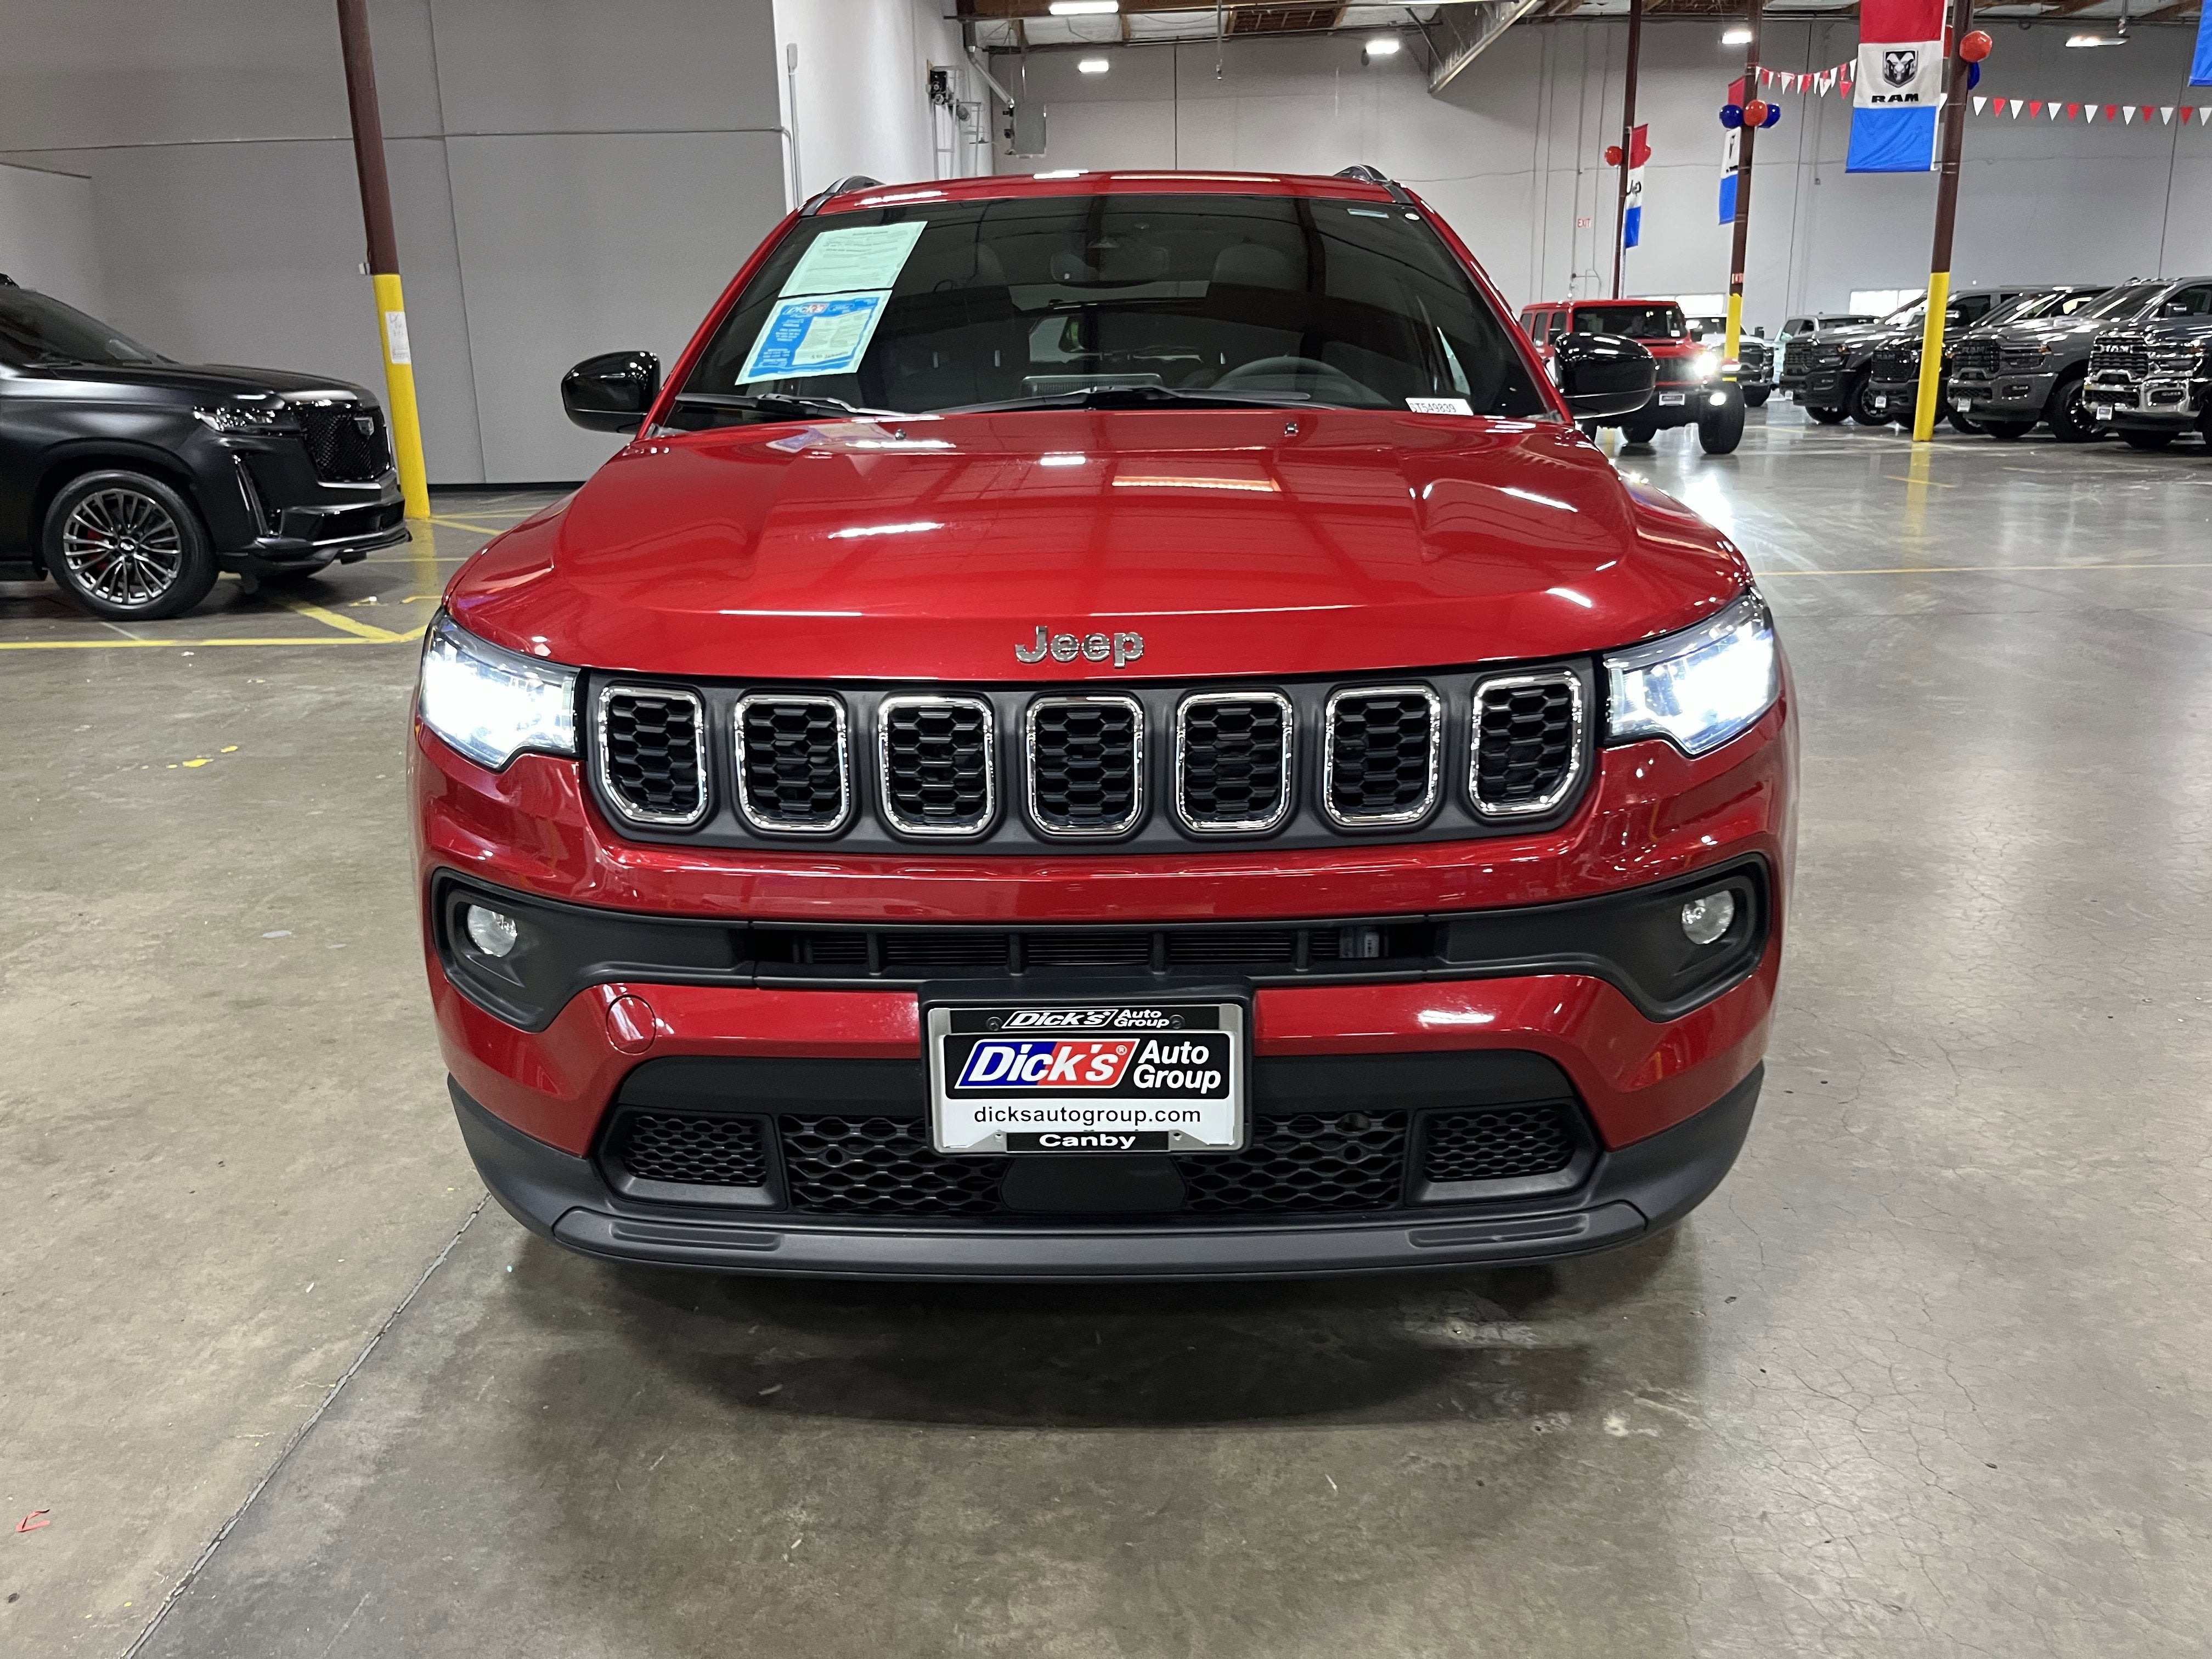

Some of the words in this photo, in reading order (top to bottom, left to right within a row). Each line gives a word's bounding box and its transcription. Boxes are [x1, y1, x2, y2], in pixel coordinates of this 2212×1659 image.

[1871, 93, 1918, 103] RAM
[1577, 218, 1590, 228] EXIT
[1015, 625, 1144, 668] Jeep
[1010, 1012, 1104, 1026] Dick's
[1118, 1009, 1162, 1018] Auto
[1114, 1018, 1170, 1028] Group
[1138, 1040, 1209, 1064] Auto
[968, 1044, 1119, 1082] Dick's
[1133, 1064, 1222, 1094] Group
[974, 1106, 1200, 1126] dicksautogroup.com
[1039, 1133, 1136, 1149] Canby
